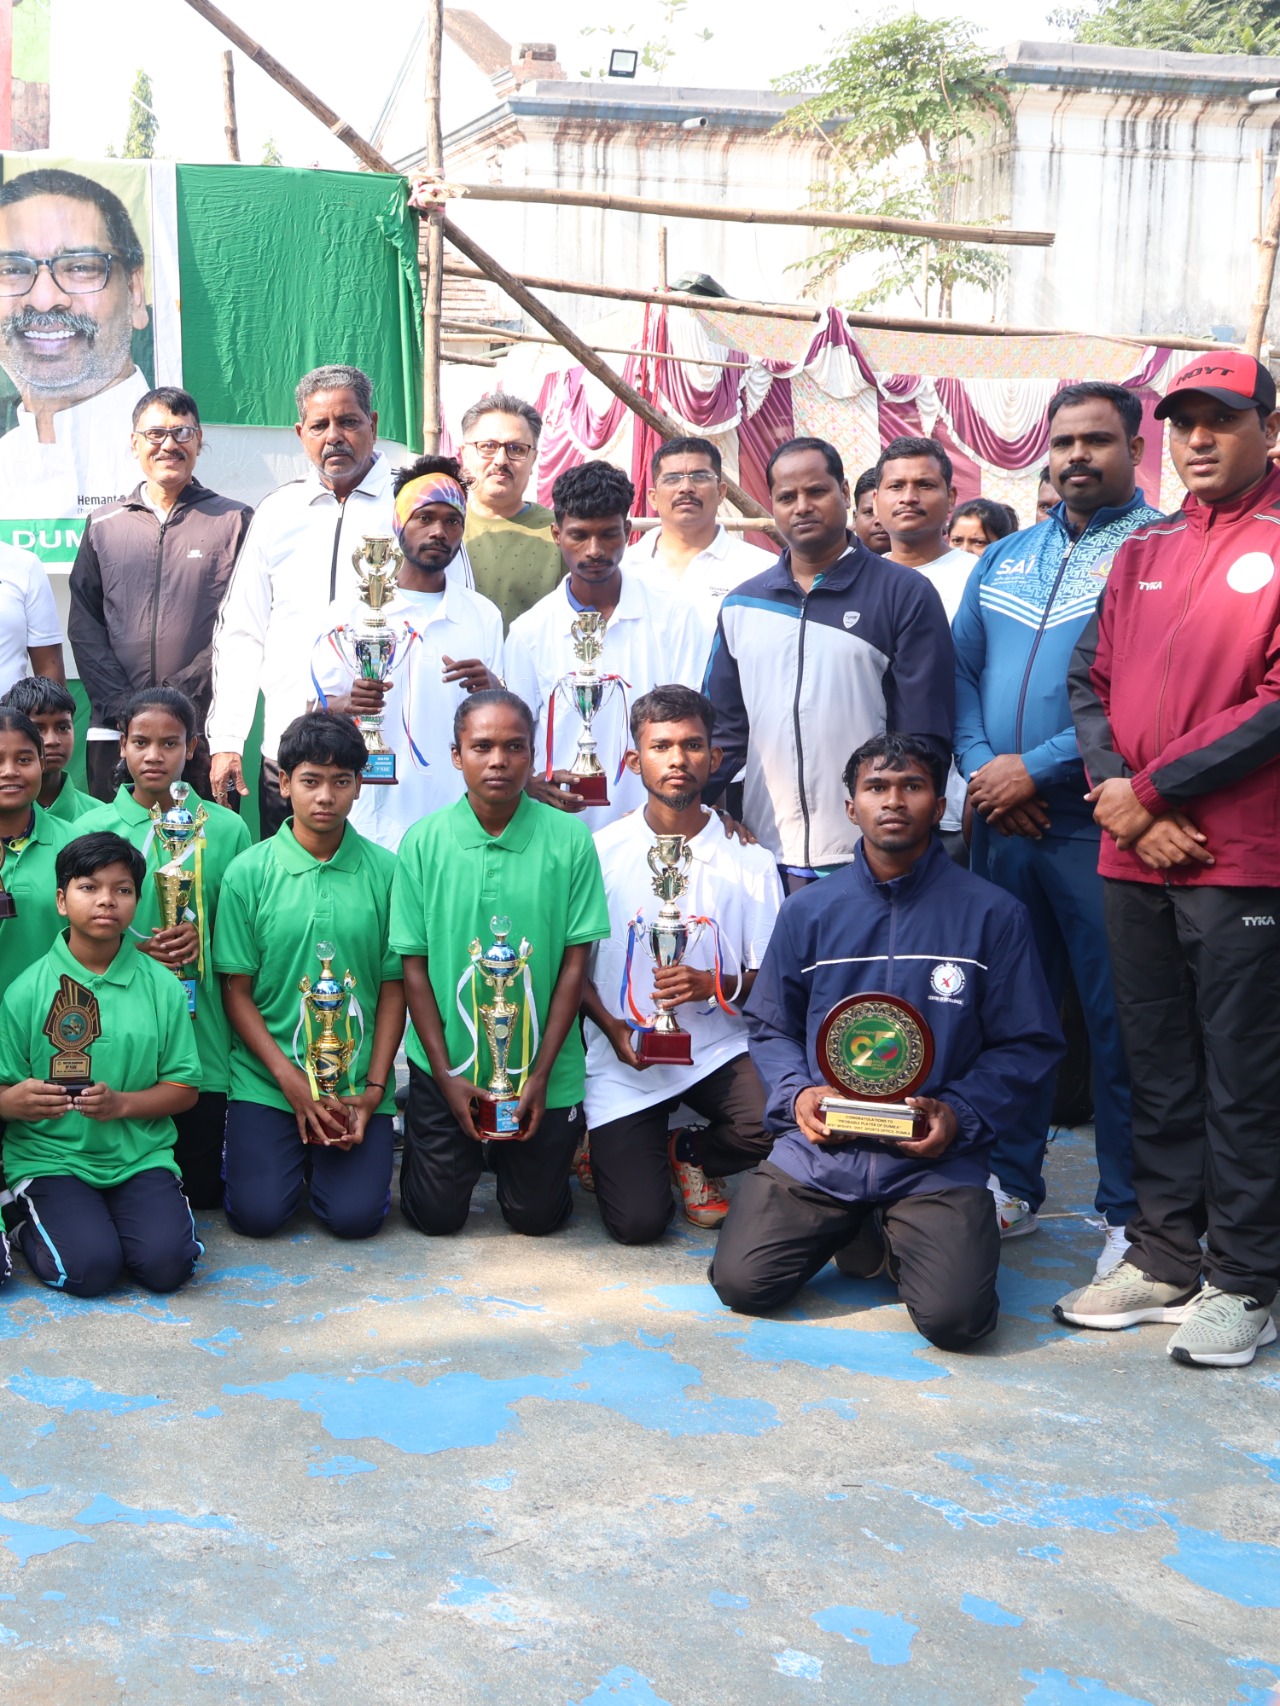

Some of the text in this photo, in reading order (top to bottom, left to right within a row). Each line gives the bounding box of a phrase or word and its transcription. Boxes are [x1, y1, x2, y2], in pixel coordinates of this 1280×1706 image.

[1176, 366, 1235, 386] HOYT
[77, 495, 117, 505] Hemant
[1139, 580, 1163, 591] TYKA
[1242, 916, 1275, 926] TYKA
